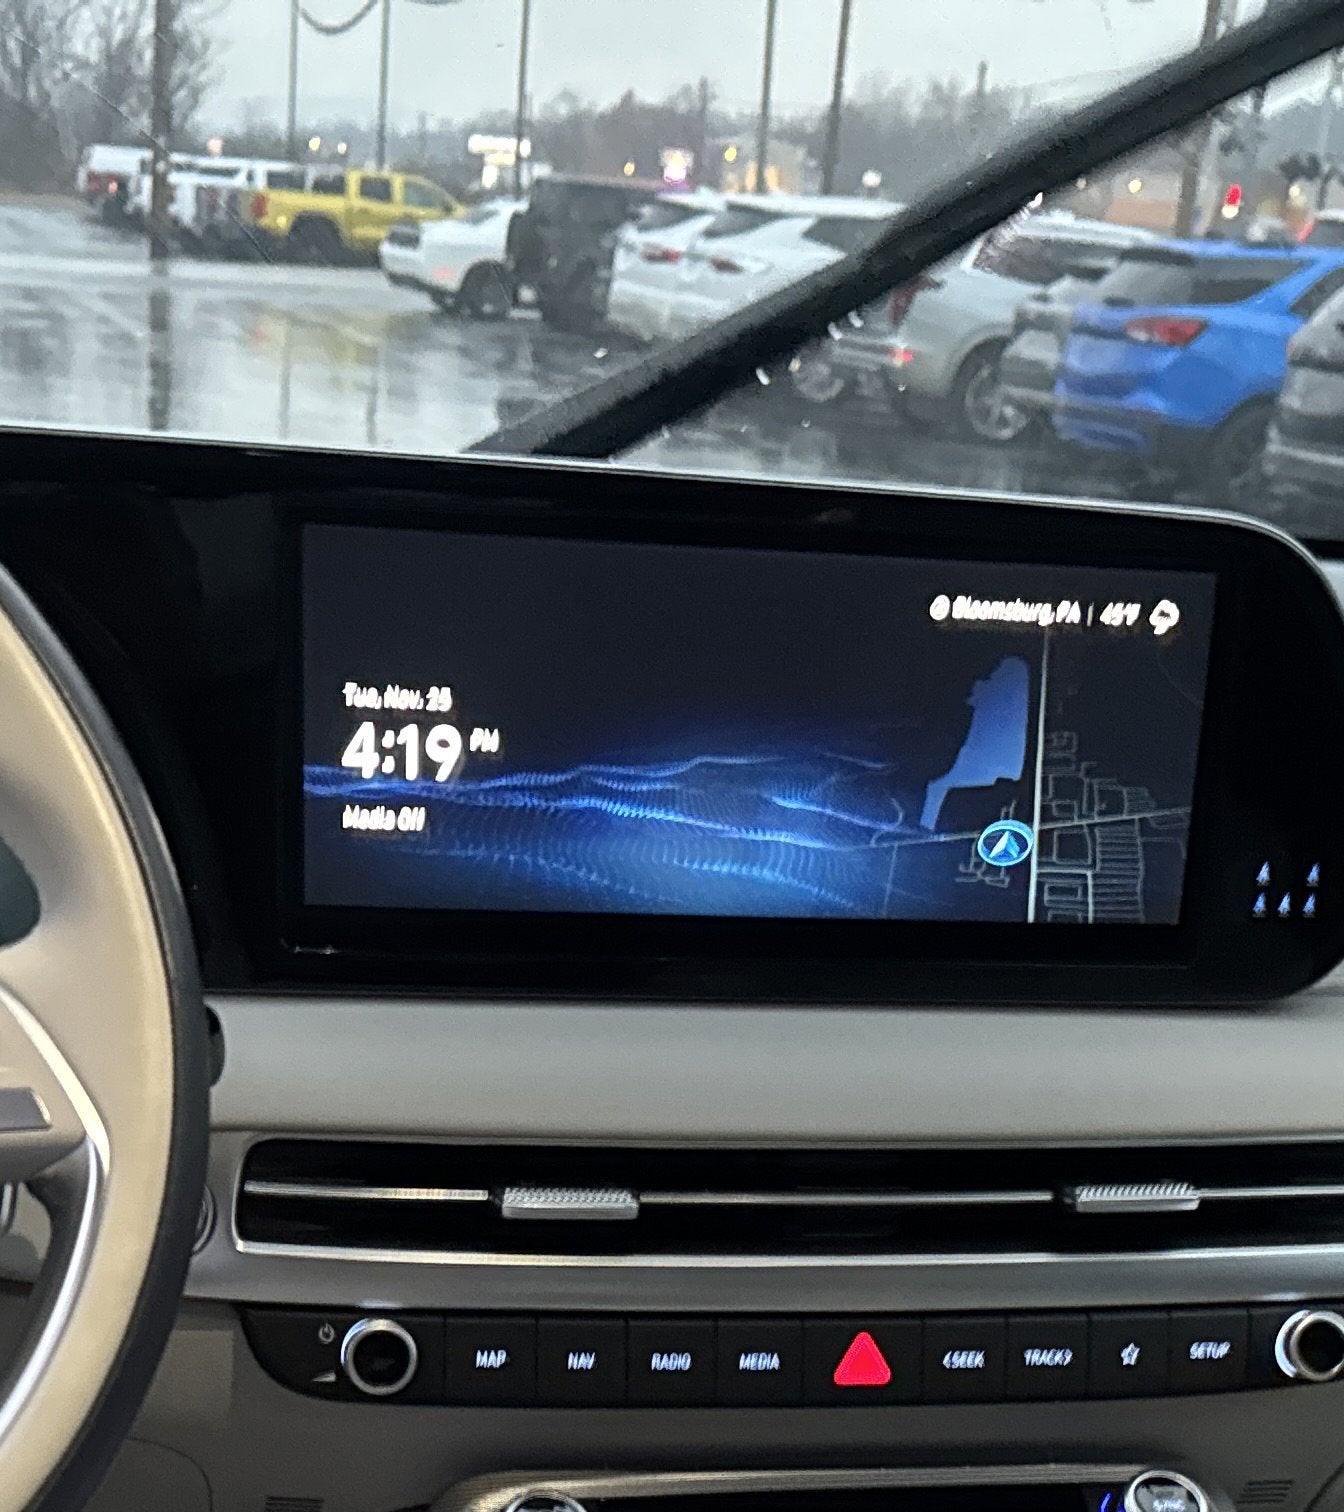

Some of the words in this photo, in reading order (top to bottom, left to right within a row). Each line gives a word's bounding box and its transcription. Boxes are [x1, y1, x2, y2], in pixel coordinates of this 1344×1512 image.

[341, 721, 463, 783] 4:19
[469, 727, 500, 753] PM
[342, 804, 395, 831] Media
[475, 1349, 507, 1369] MAP
[1189, 1341, 1231, 1360] SETUP
[567, 1351, 596, 1370] NAV
[651, 1352, 692, 1371] RADIO
[738, 1352, 781, 1371] MEDIA
